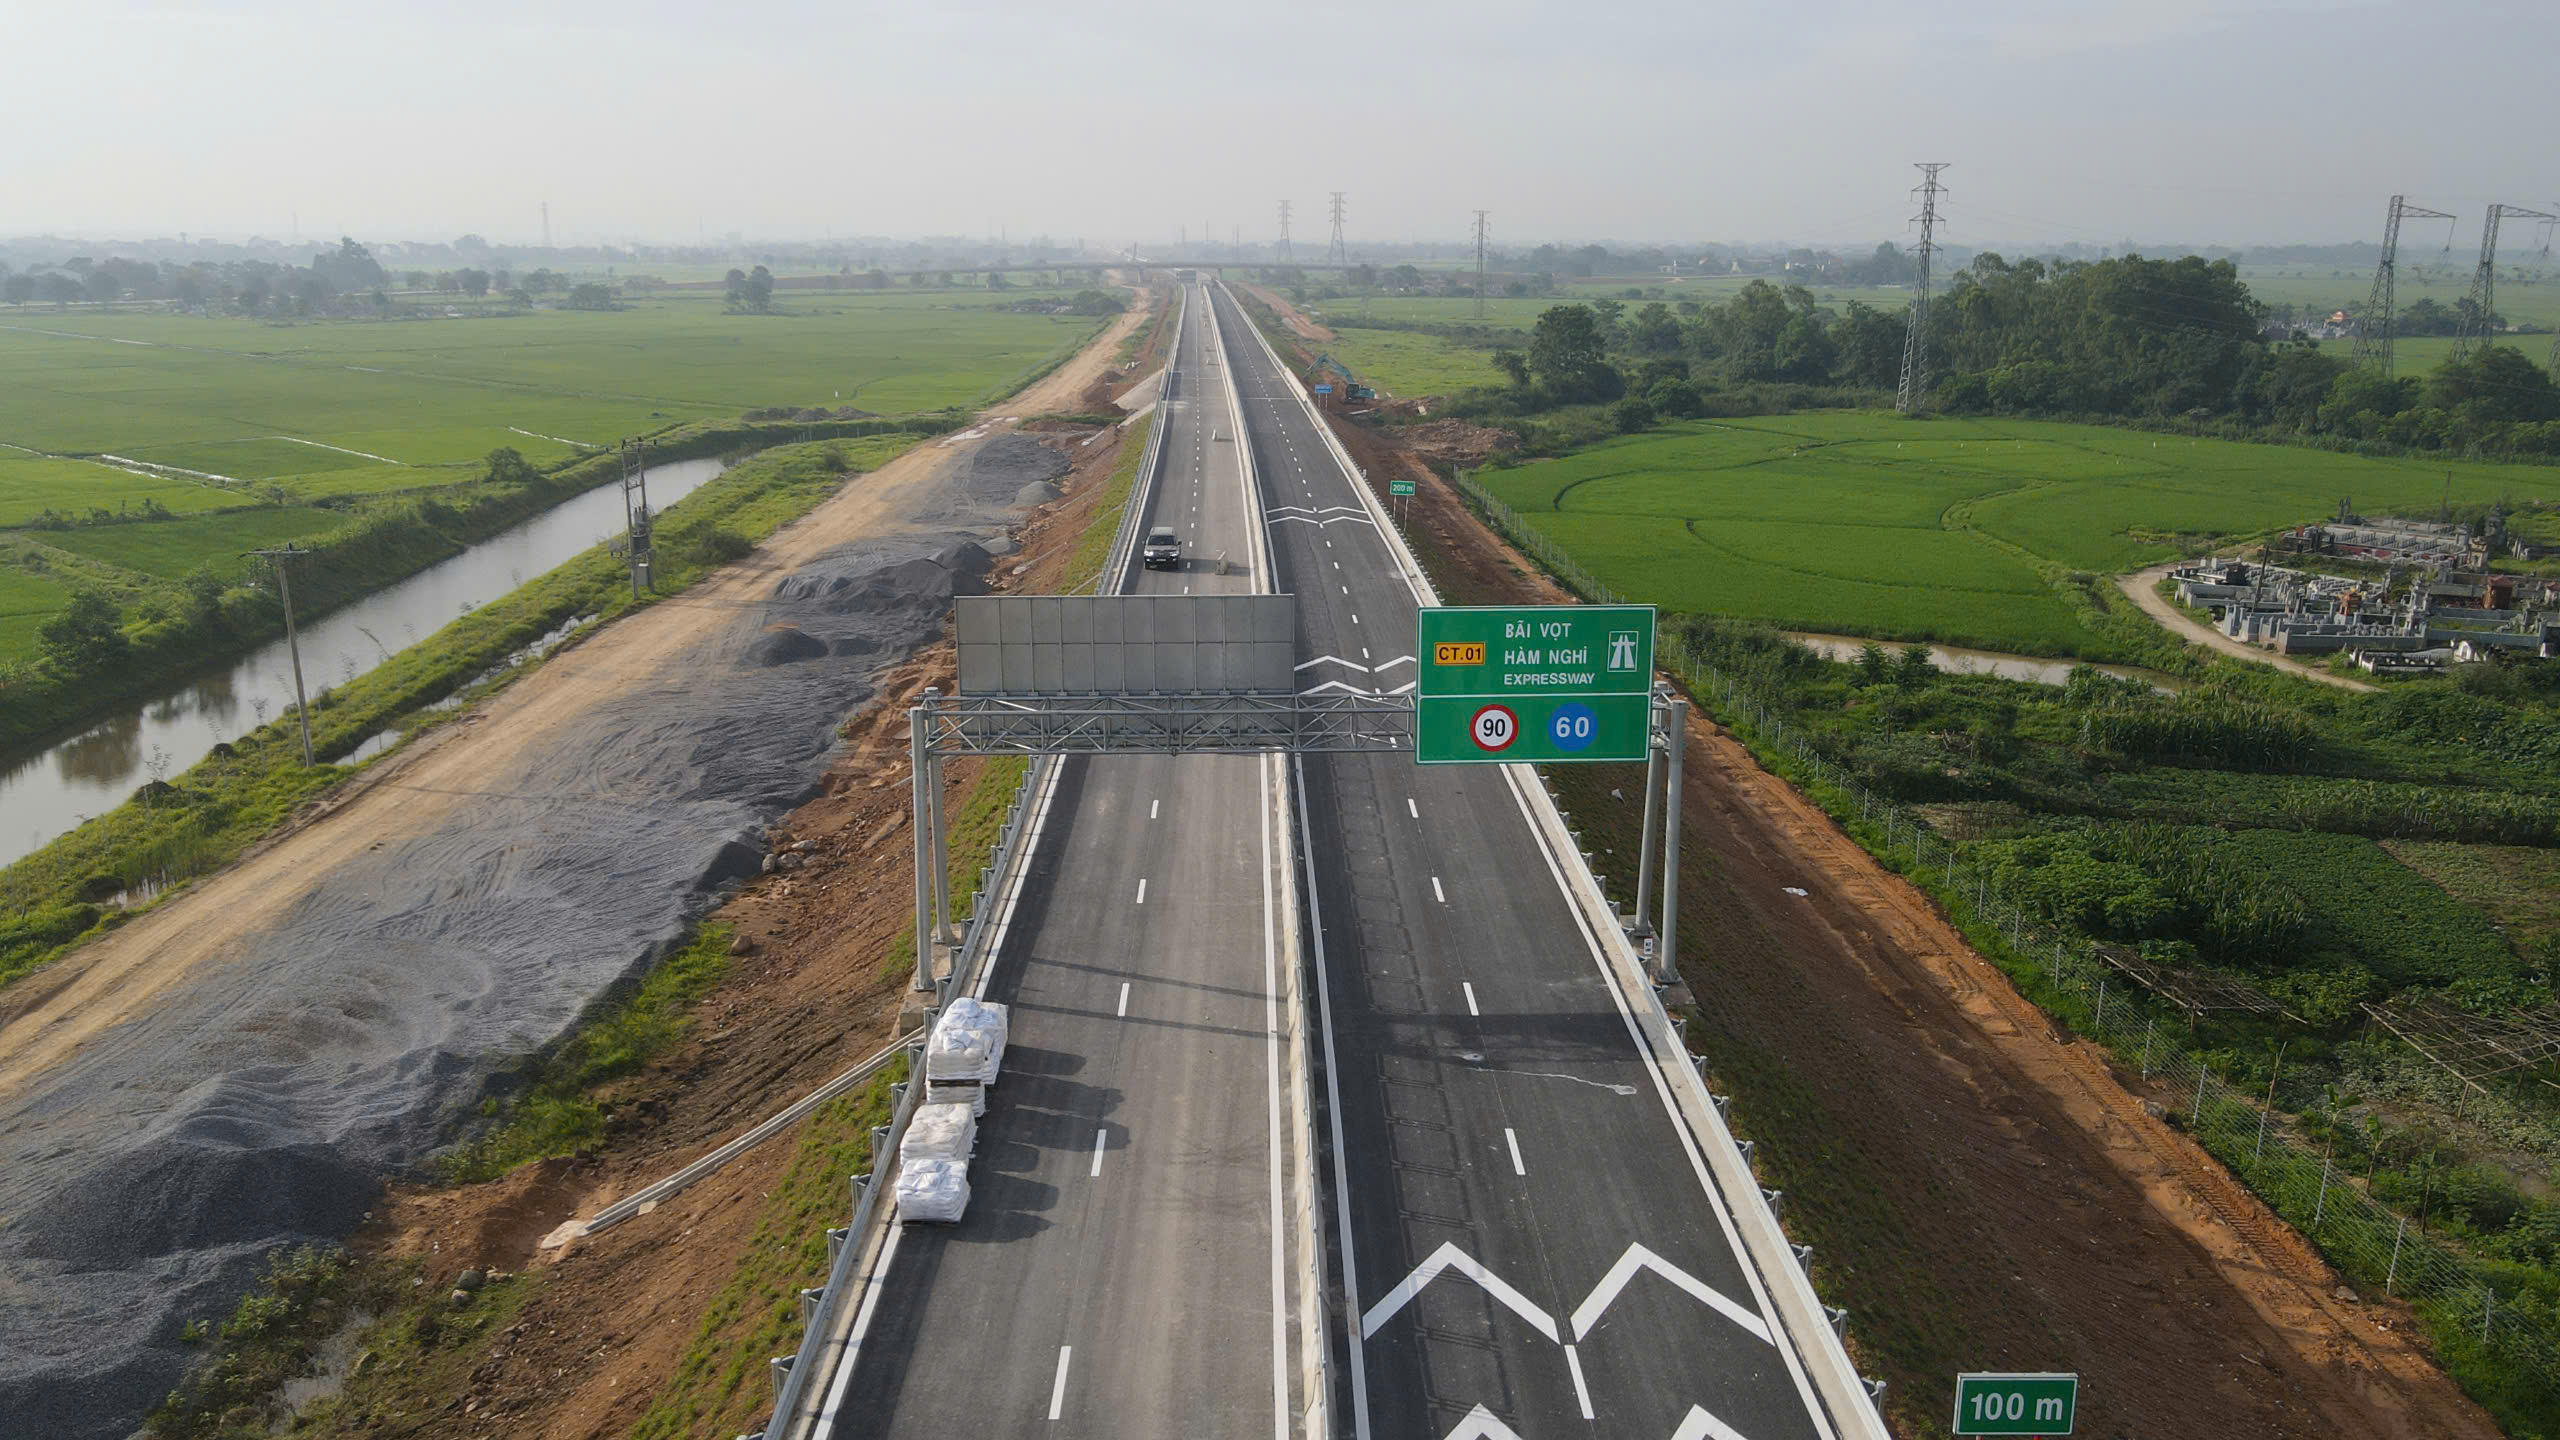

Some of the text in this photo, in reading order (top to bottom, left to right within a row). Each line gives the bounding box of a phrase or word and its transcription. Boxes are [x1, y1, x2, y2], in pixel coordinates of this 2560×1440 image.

[1505, 620, 1572, 641] BÃI VỌT
[1439, 647, 1481, 661] CT.01
[1504, 646, 1540, 665] HÀM
[1504, 672, 1595, 685] EXPRESSWAY
[1483, 718, 1506, 737] 90
[1556, 716, 1590, 738] 60
[1970, 1392, 2063, 1421] 100 m
